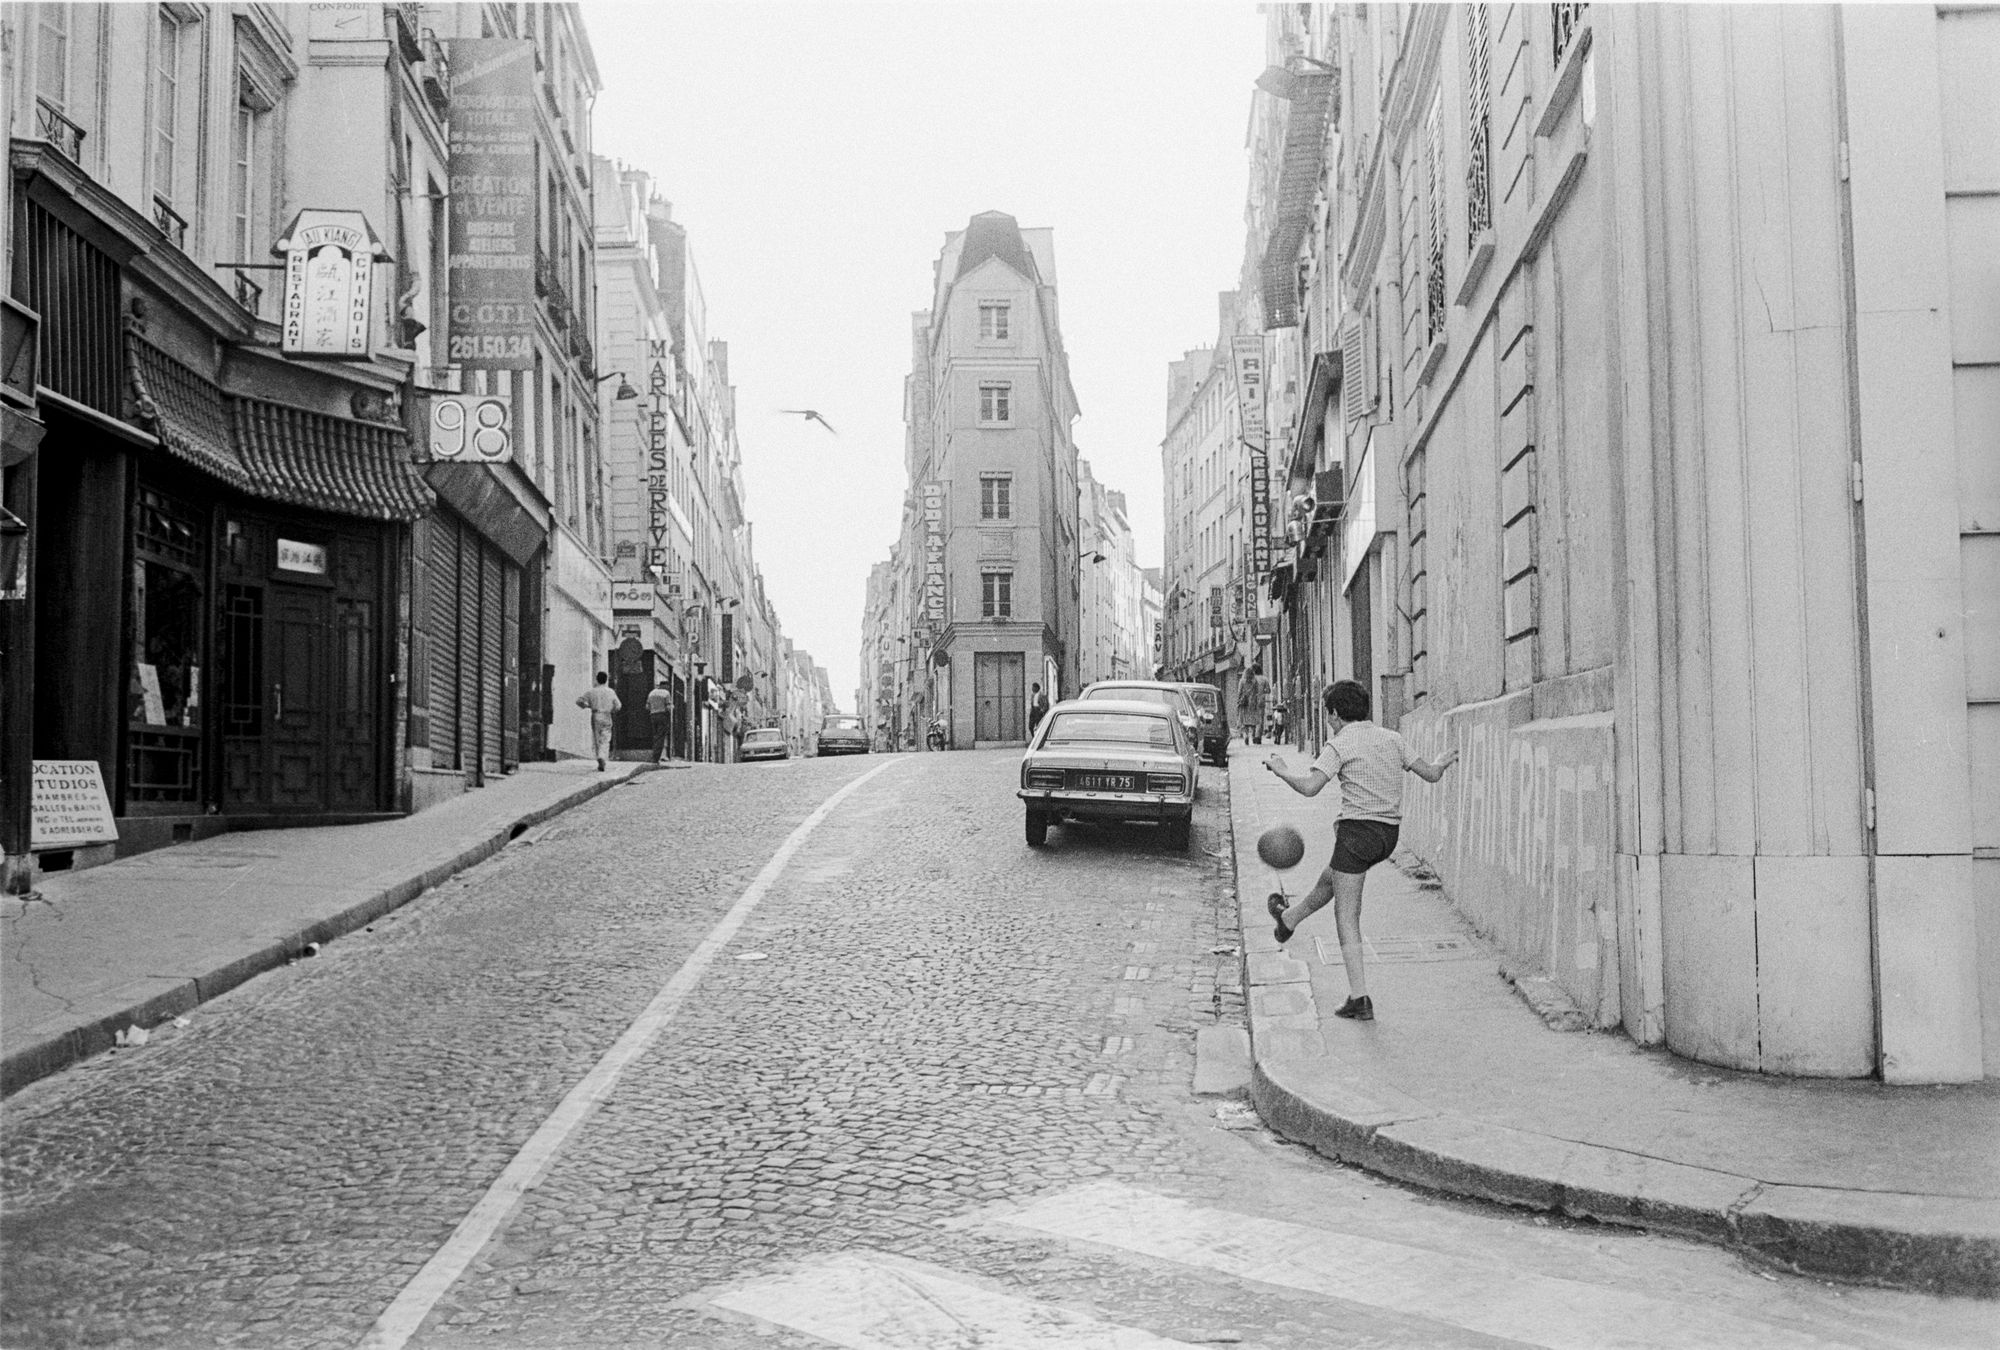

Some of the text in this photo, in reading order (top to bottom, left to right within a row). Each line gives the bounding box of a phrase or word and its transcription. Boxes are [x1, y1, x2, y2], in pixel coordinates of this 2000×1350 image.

[464, 110, 517, 126] TOTALE
[451, 175, 531, 195] CREATION
[475, 197, 526, 215] VENTE
[288, 255, 302, 346] RESTAURANT
[352, 258, 366, 348] CHINOIS
[648, 339, 667, 472] MARIEES
[434, 399, 509, 459] 98
[1252, 457, 1270, 572] RESTAURANT
[648, 491, 668, 568] REVE
[32, 764, 95, 775] OCATION
[34, 779, 98, 790] TUDIOS
[1119, 777, 1131, 788] 75
[35, 793, 87, 801] HAMBRES
